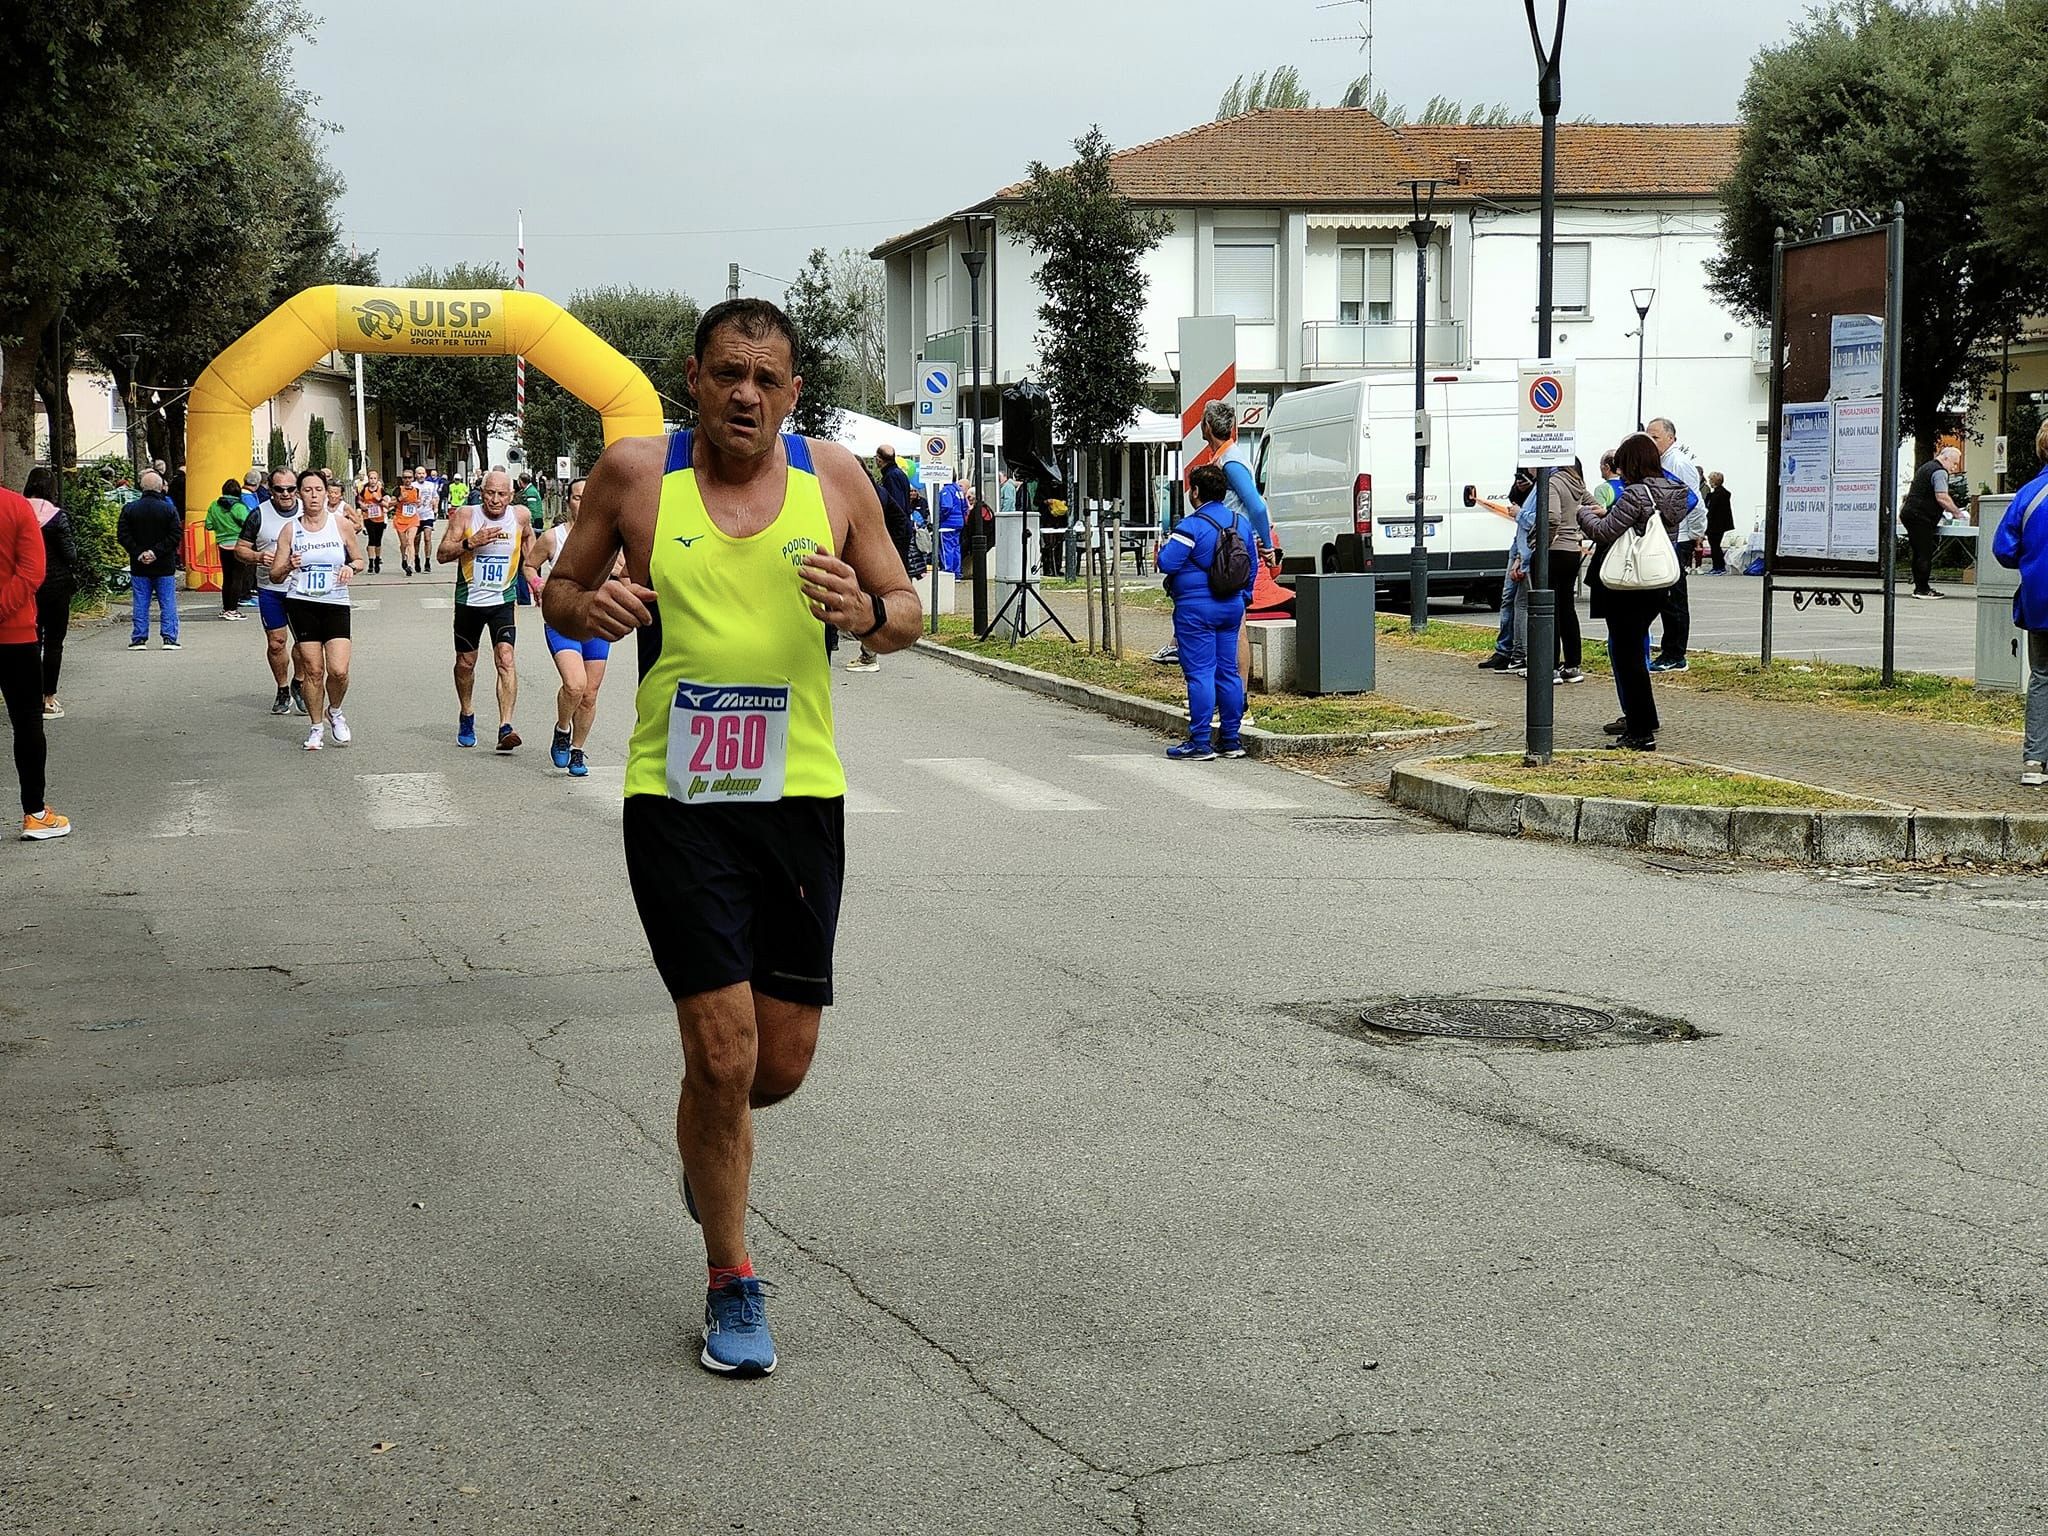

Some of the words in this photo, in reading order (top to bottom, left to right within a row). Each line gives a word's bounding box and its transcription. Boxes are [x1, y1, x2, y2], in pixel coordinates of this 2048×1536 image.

[409, 300, 491, 328] UISP
[410, 329, 447, 338] UNIONE
[450, 330, 492, 339] ITALIANA
[410, 338, 439, 346] SPORT
[463, 339, 487, 347] TUTTI
[1833, 347, 1854, 368] Ivan
[1855, 344, 1881, 366] Alvisi
[1857, 425, 1880, 436] NATALIA
[1785, 500, 1807, 512] ALVISI
[1808, 500, 1826, 512] IVAN
[782, 537, 819, 560] PODISTIC
[307, 572, 326, 589] 113
[482, 564, 503, 581] 194
[689, 713, 767, 772] 260
